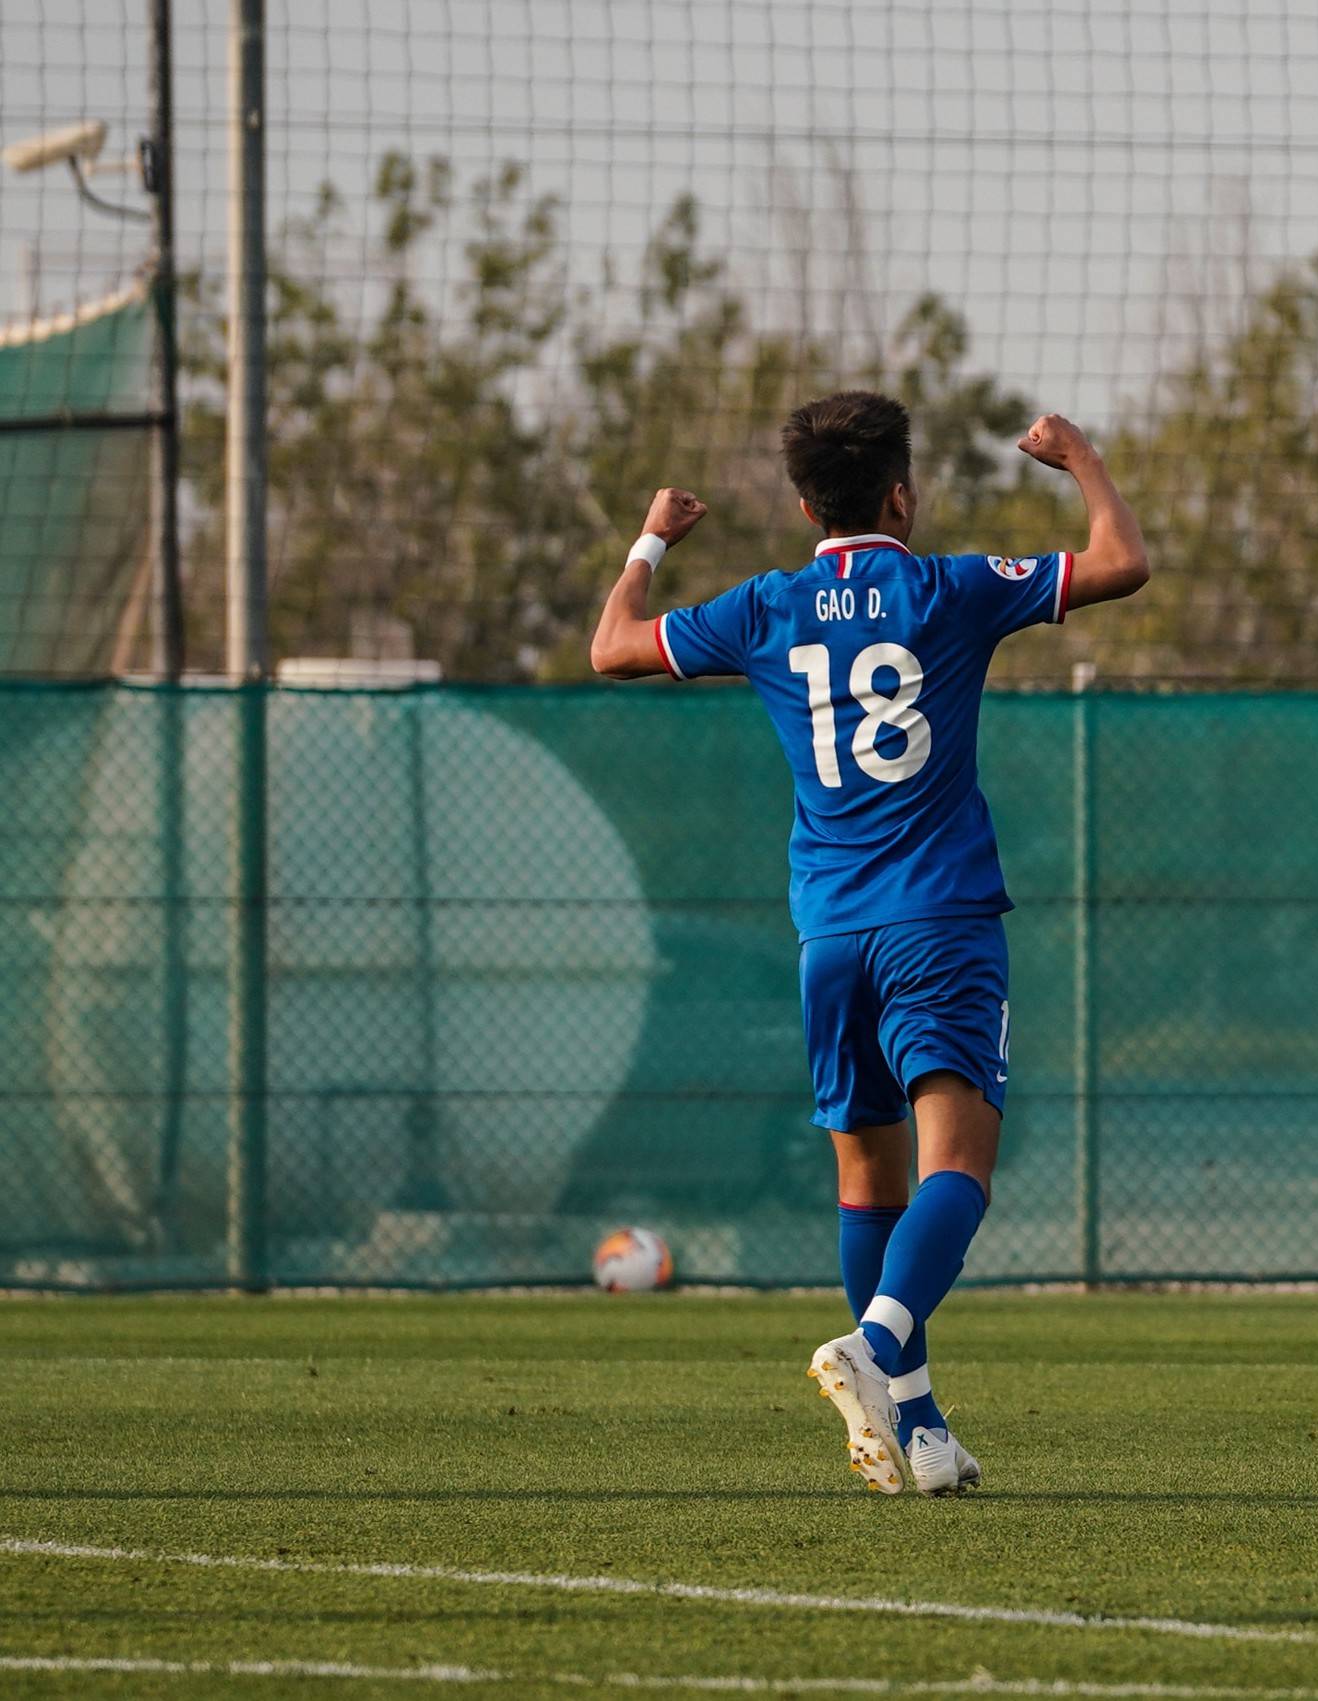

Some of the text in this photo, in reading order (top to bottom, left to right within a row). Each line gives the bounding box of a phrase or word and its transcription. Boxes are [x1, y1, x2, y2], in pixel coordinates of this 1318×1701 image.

[815, 588, 887, 622] GAO D.
[788, 642, 932, 788] 18
